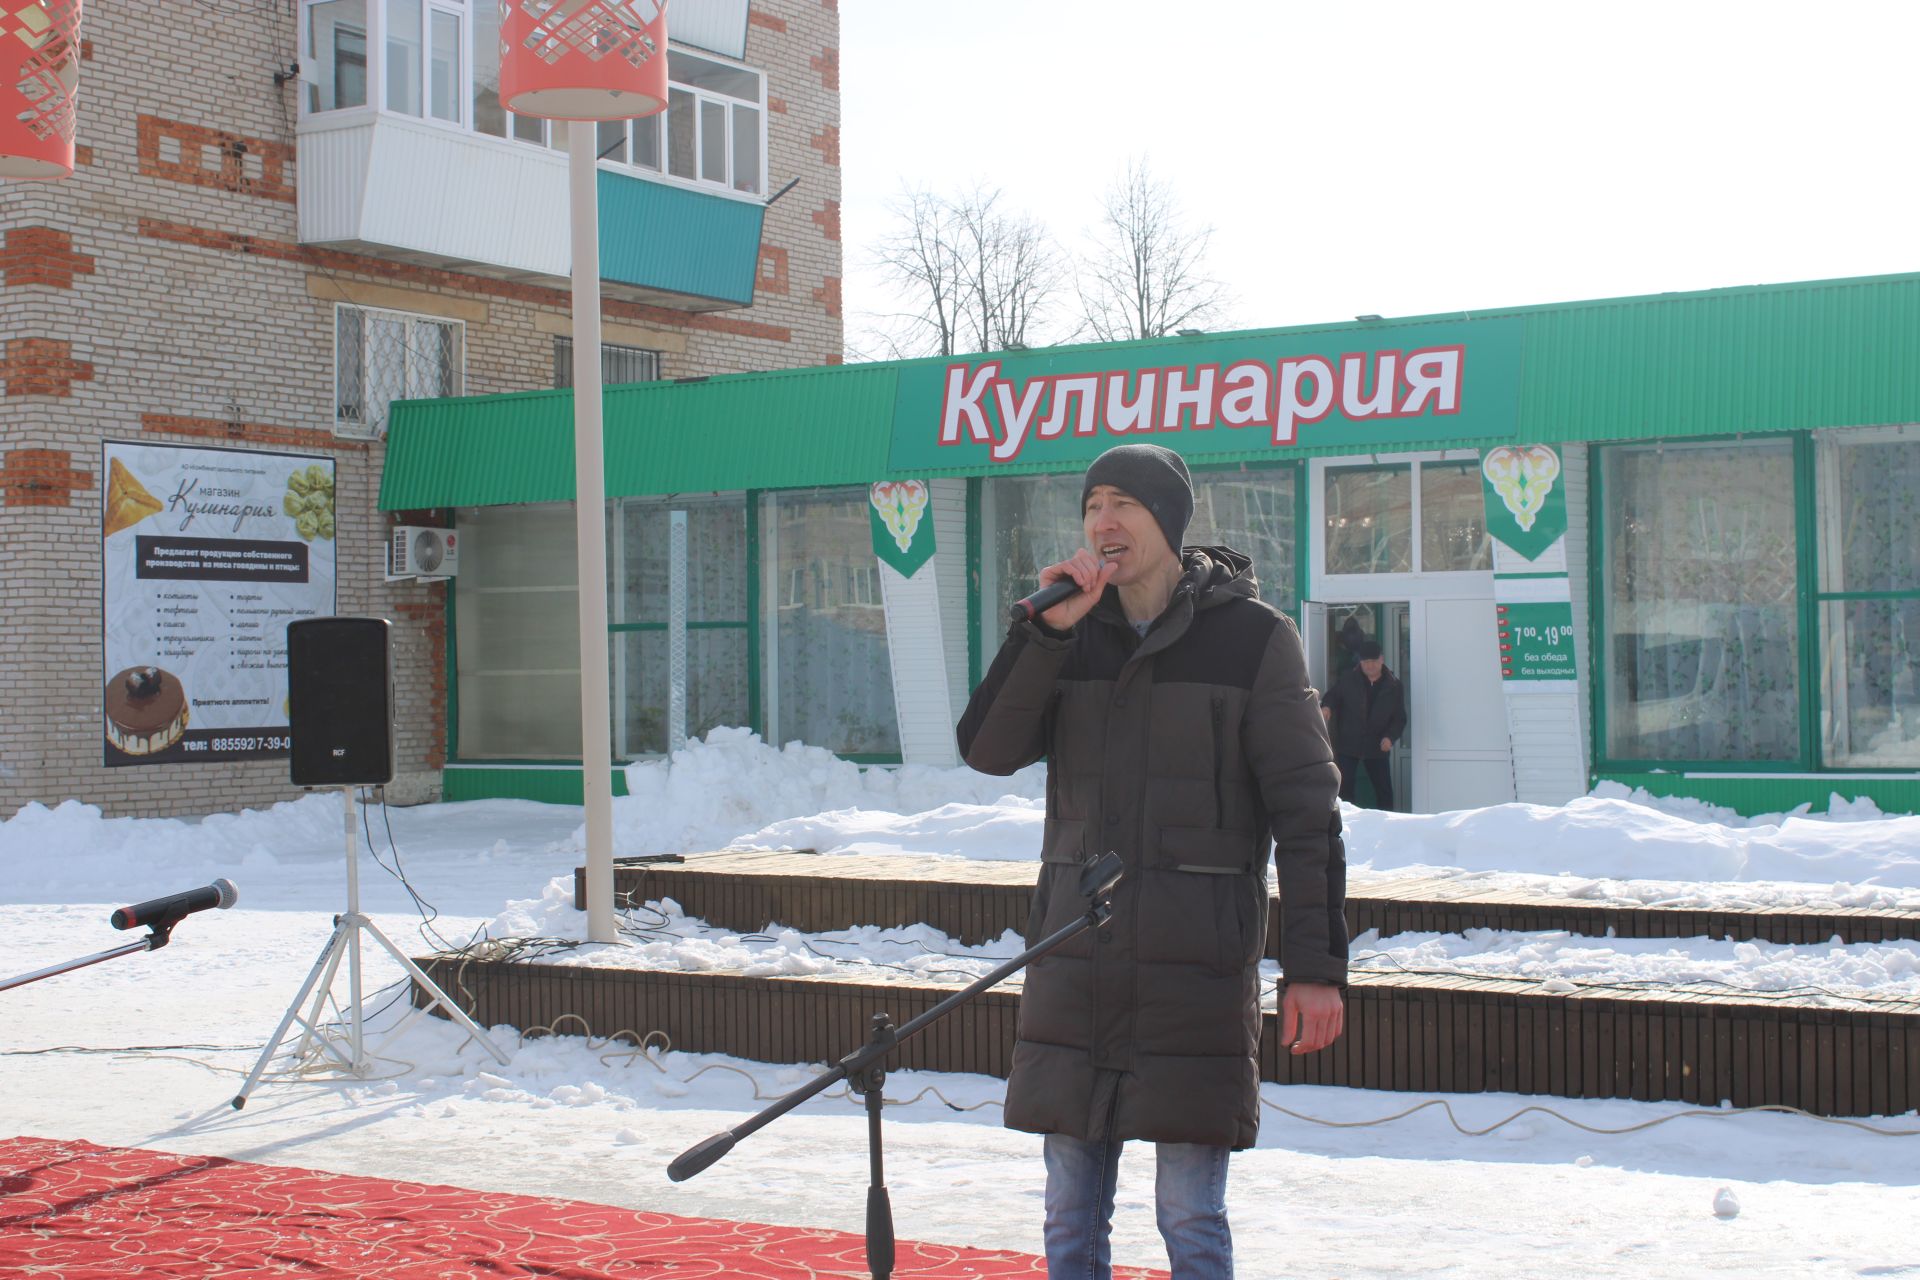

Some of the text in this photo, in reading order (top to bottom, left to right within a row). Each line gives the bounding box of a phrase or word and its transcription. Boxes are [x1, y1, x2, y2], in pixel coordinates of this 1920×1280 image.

[938, 344, 1465, 463] Кулинария
[200, 487, 240, 498] магазин
[168, 478, 277, 532] Кулинария
[154, 546, 293, 560] Предлагает продукцию собственного
[145, 560, 200, 569] производства
[213, 561, 232, 569] мяса
[233, 562, 268, 571] говядины
[275, 563, 300, 572] птицы:
[273, 649, 288, 658] зака
[1524, 652, 1568, 663] без обеда
[1521, 667, 1576, 676] без выходных
[192, 698, 231, 708] Приятного
[183, 740, 208, 752] тел:
[257, 736, 290, 750] 7-39-0
[332, 749, 345, 757] RCF
